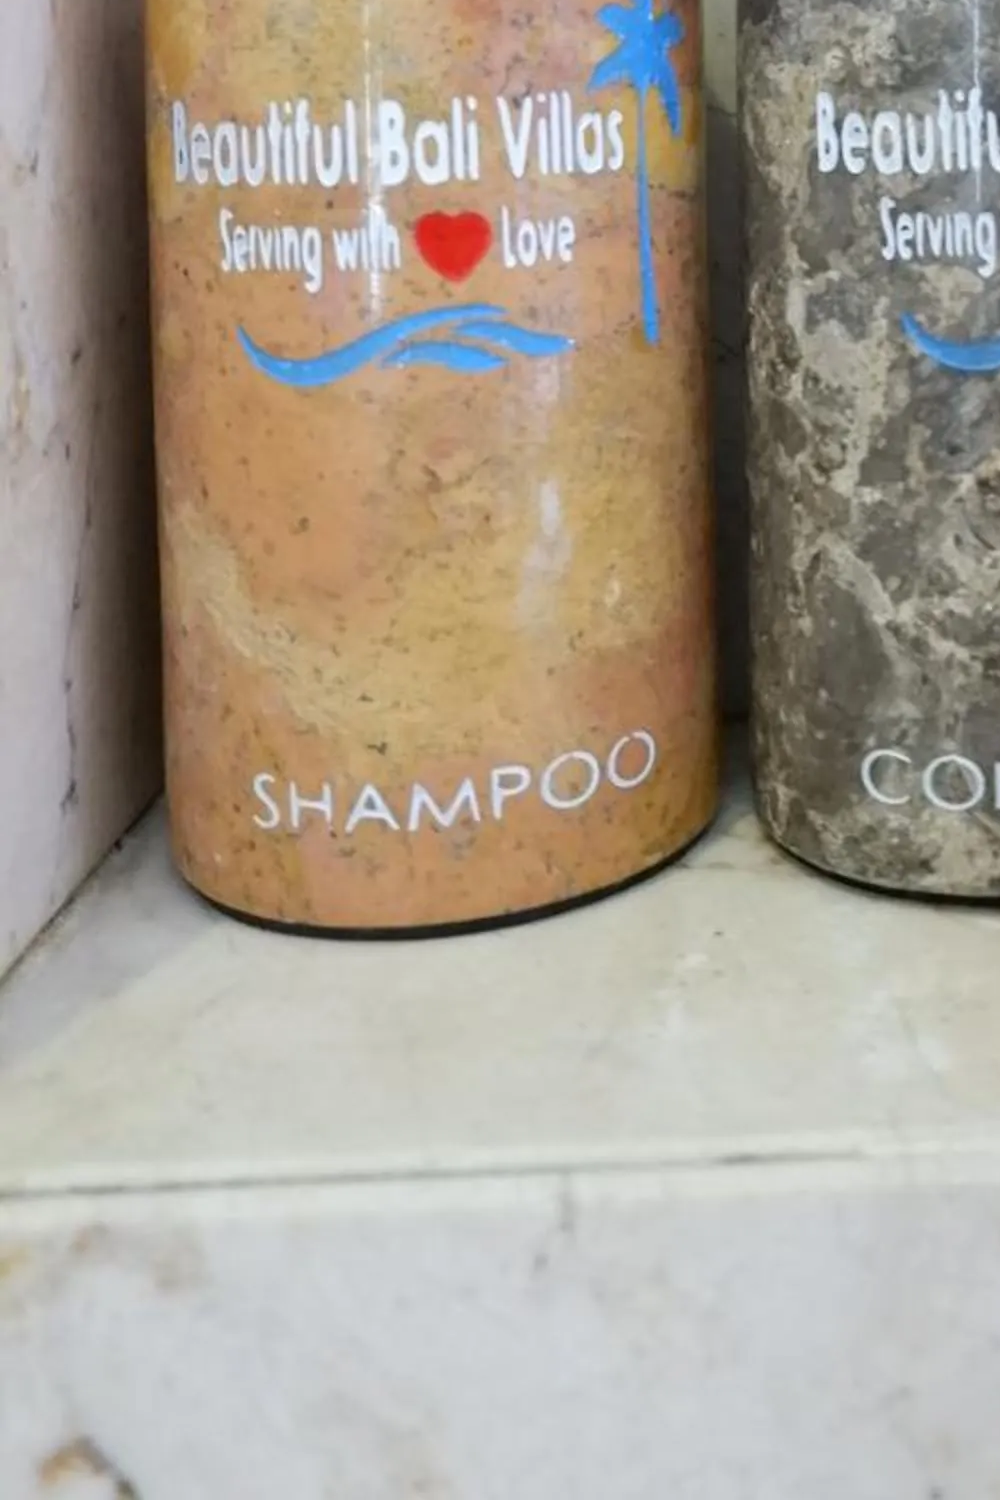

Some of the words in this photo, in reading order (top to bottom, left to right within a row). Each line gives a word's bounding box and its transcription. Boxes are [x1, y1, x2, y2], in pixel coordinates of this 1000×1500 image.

[172, 99, 360, 188] Beautiful
[377, 95, 480, 187] Bali
[496, 90, 624, 179] Villas
[218, 207, 323, 293] Serving
[333, 202, 400, 271] with
[878, 196, 996, 278] Serving
[252, 730, 657, 833] SHAMPOO
